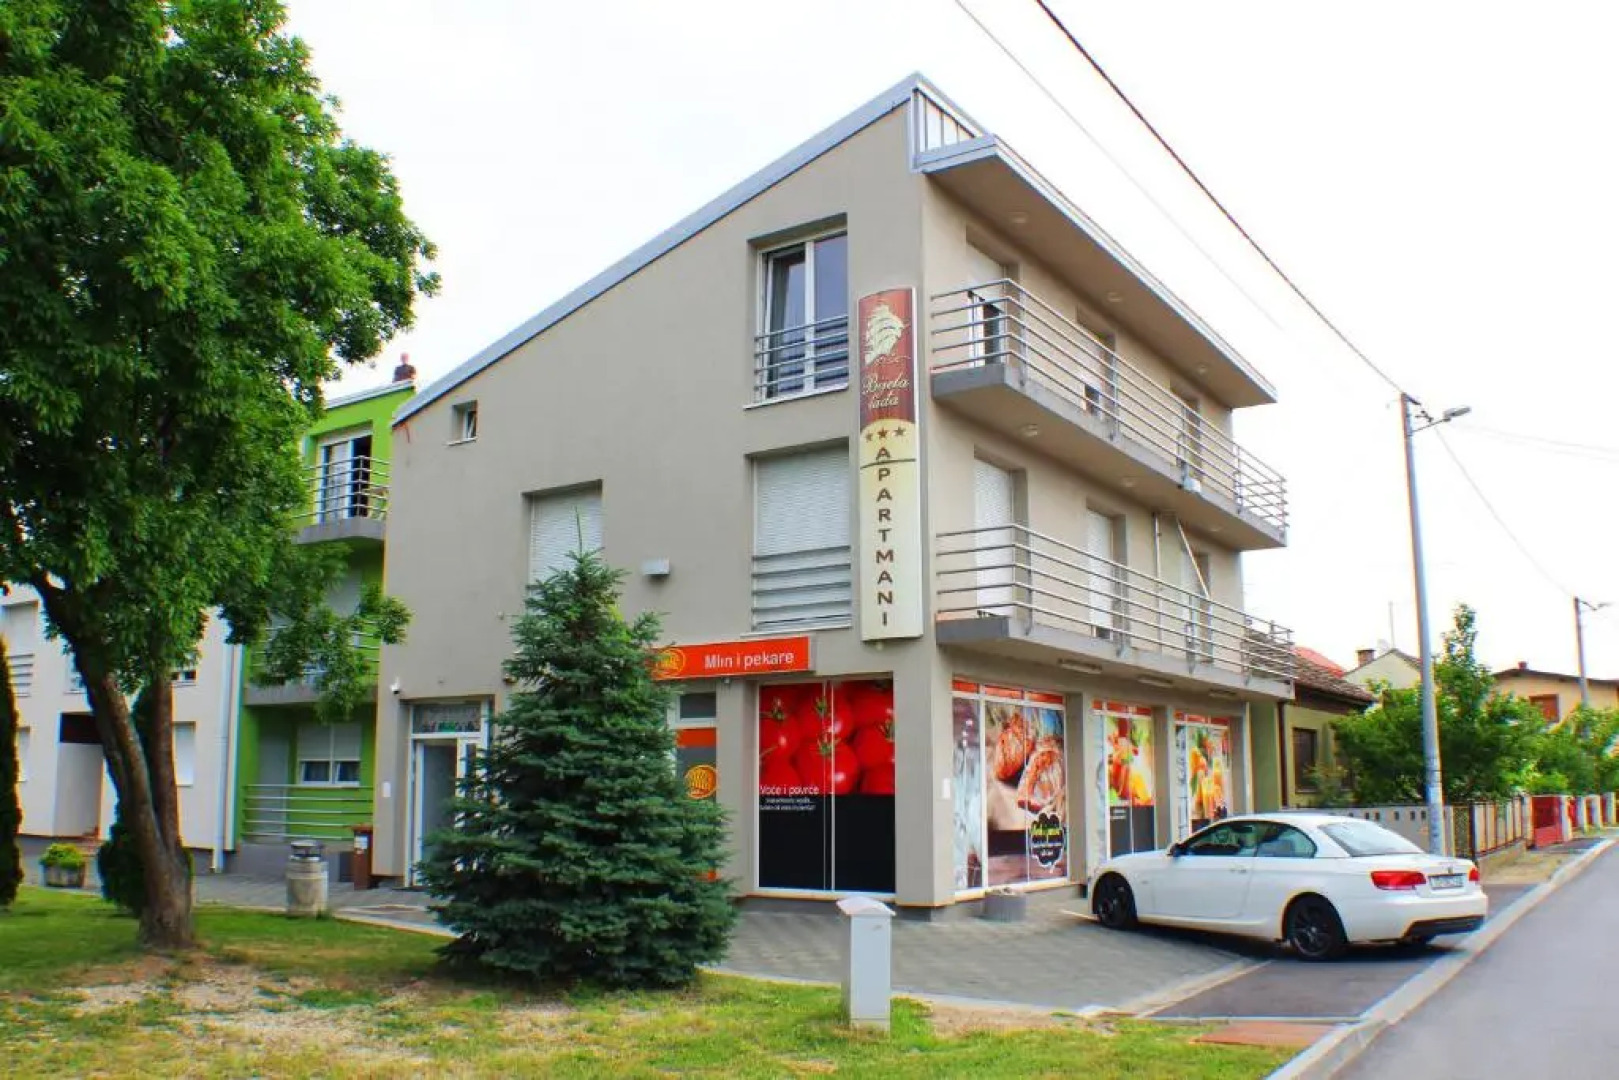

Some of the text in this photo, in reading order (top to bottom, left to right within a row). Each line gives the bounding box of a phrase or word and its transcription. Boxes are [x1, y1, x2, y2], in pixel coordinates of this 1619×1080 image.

[875, 447, 894, 626] APARTMANI
[704, 654, 733, 669] Mlin
[744, 651, 795, 670] pekare
